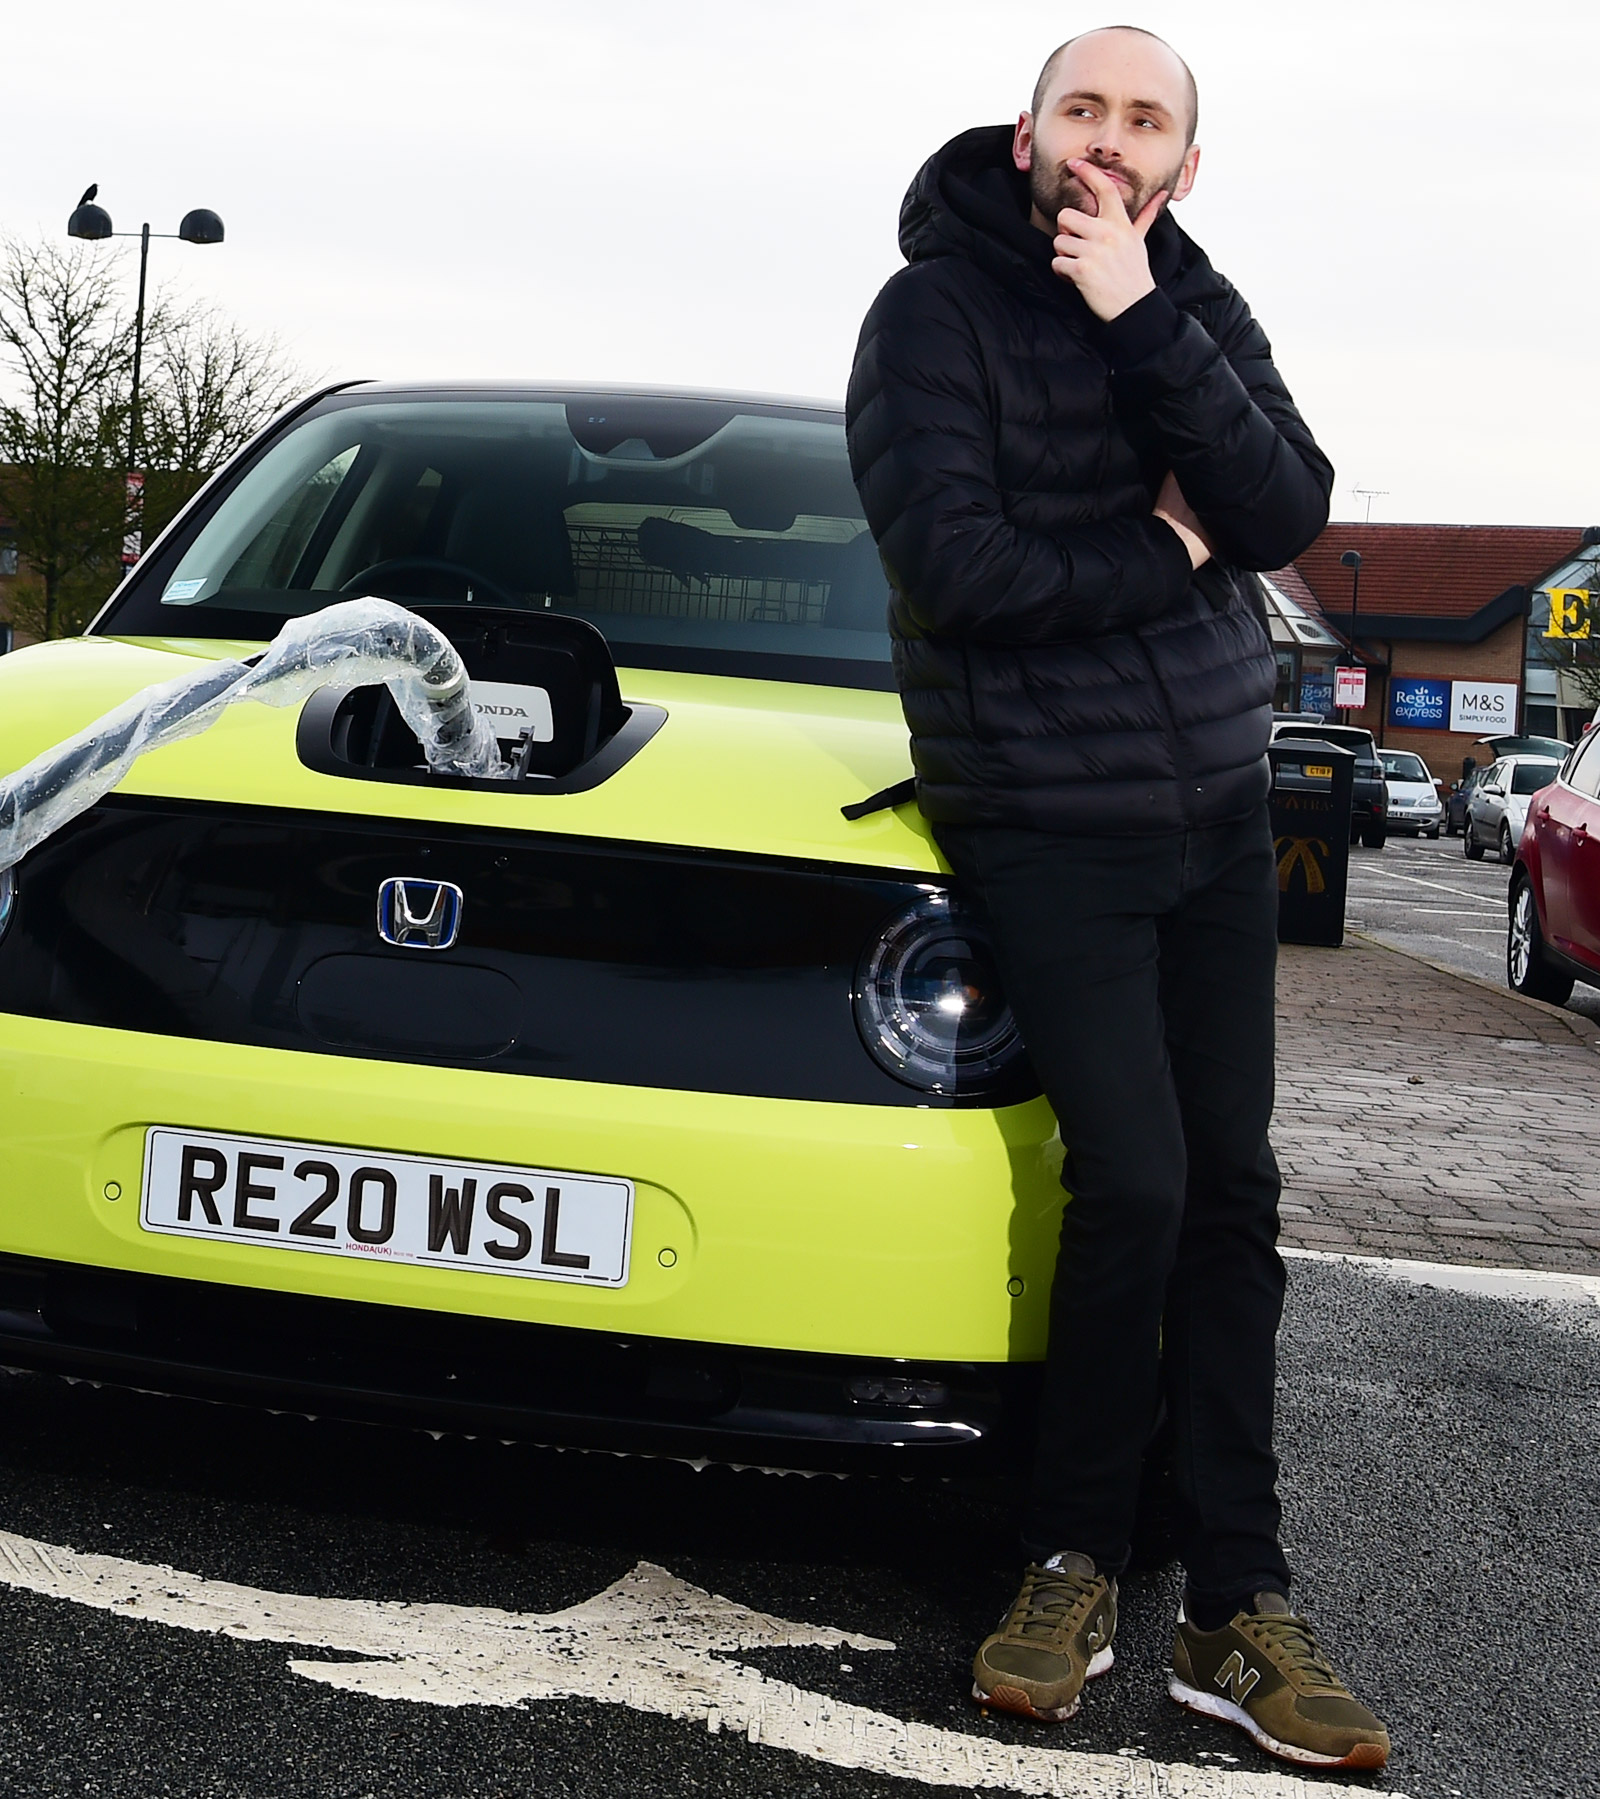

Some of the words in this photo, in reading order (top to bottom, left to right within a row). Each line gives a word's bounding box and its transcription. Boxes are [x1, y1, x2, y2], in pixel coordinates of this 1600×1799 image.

[1395, 689, 1444, 708] Regus
[1462, 693, 1505, 712] M&S
[473, 703, 529, 718] ONDA
[1395, 706, 1443, 719] express
[1459, 714, 1484, 723] SIMPLY
[1485, 715, 1507, 724] FOOD
[176, 1144, 398, 1245] RE20
[427, 1173, 591, 1270] WSL
[345, 1242, 393, 1256] HONDA(UK)
[1213, 1649, 1261, 1707] N
